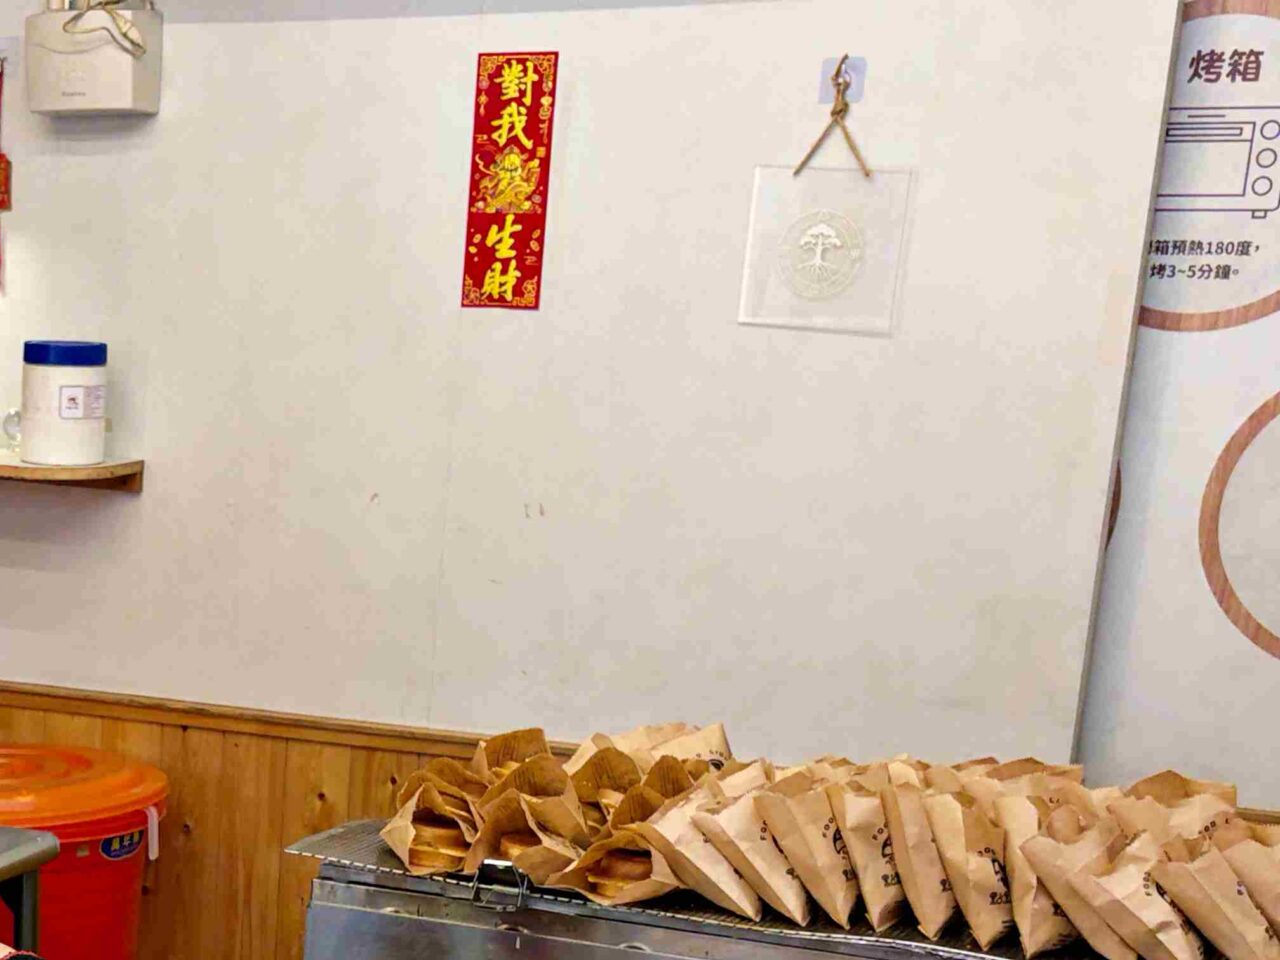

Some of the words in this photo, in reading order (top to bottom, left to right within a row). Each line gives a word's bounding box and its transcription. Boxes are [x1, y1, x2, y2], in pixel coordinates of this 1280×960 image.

[1187, 49, 1265, 84] 烤箱
[481, 59, 539, 302] 對我生財
[1148, 240, 1260, 257] 箱預熱180度,
